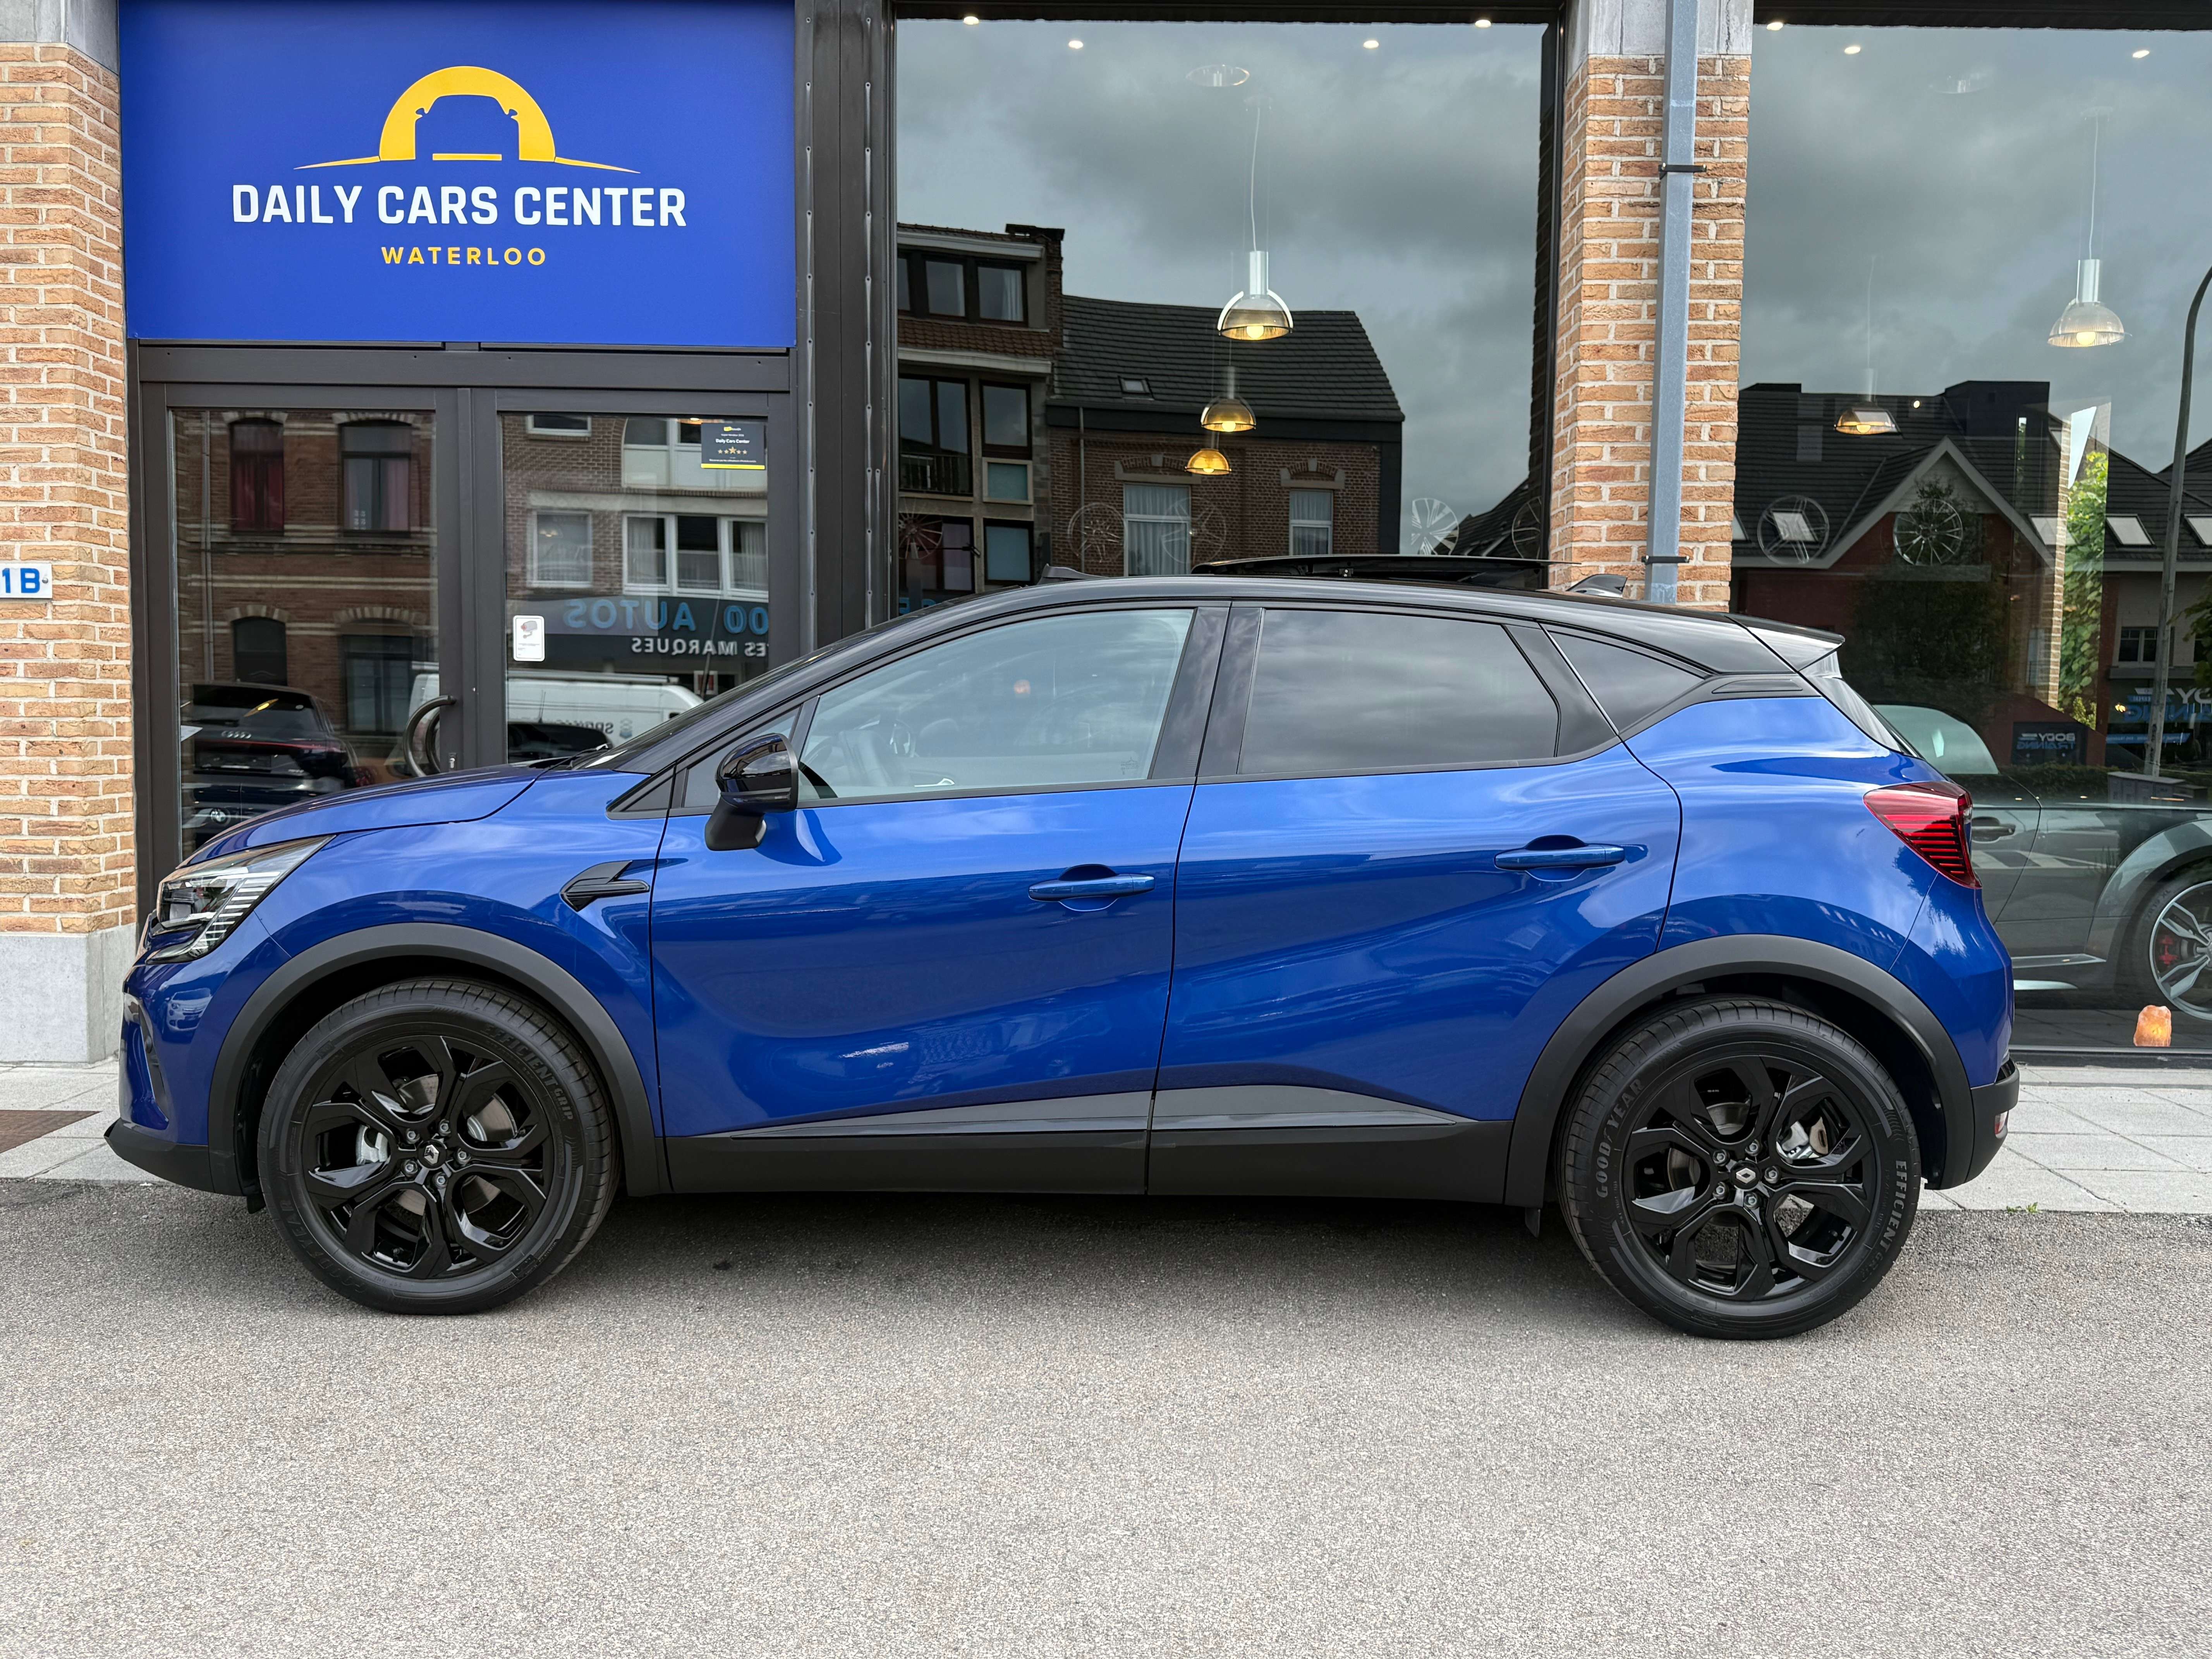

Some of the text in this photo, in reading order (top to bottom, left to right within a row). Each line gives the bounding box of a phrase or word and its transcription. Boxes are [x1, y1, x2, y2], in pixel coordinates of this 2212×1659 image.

[233, 185, 687, 227] DAILY CARS CENTER
[381, 247, 546, 266] WATERLOO
[554, 1087, 574, 1120] GRIP
[1595, 1078, 1645, 1199] GOODYEAR
[1879, 1160, 1908, 1253] EFFICIENT
